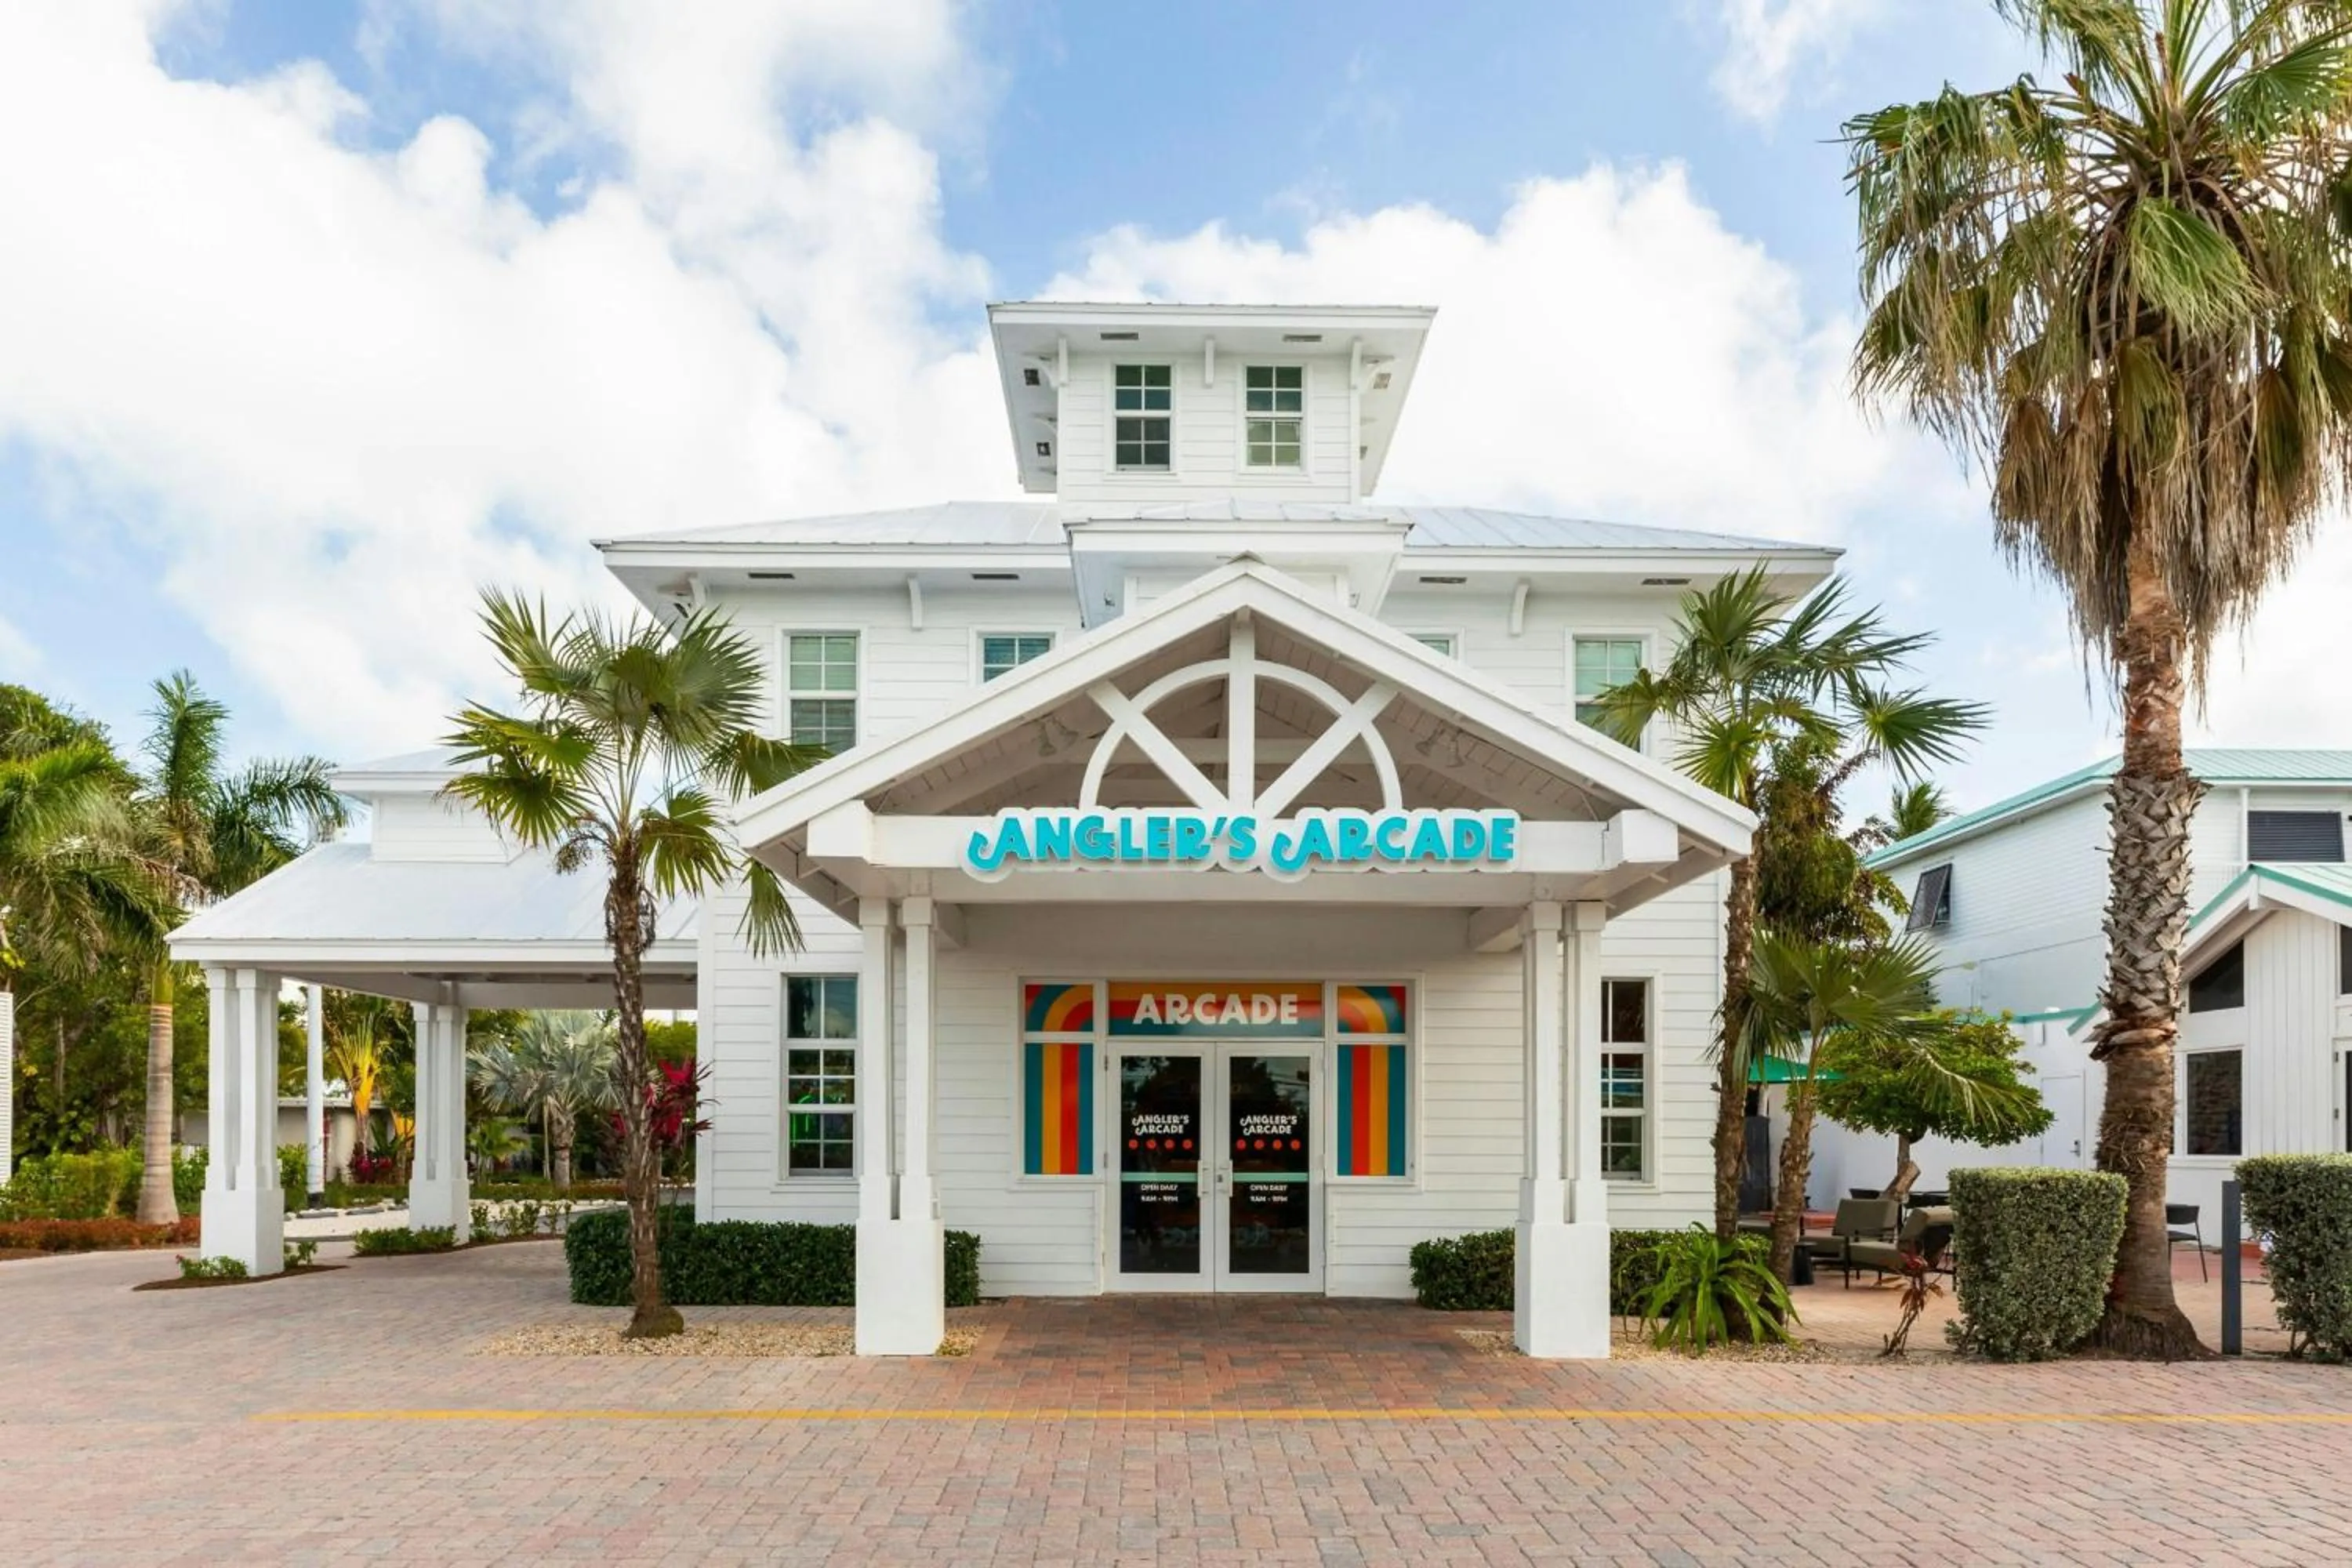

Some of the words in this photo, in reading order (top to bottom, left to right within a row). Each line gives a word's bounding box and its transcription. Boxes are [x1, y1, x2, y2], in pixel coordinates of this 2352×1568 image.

[967, 816, 1257, 871] ANGLER'S
[1270, 817, 1515, 871] ARCADE
[1132, 993, 1298, 1025] ARCADE
[1131, 1114, 1189, 1126] ANGLER'S
[1240, 1115, 1298, 1127] ANGLER'S
[1135, 1125, 1184, 1136] ARCADE
[1243, 1125, 1292, 1136] ARCADE
